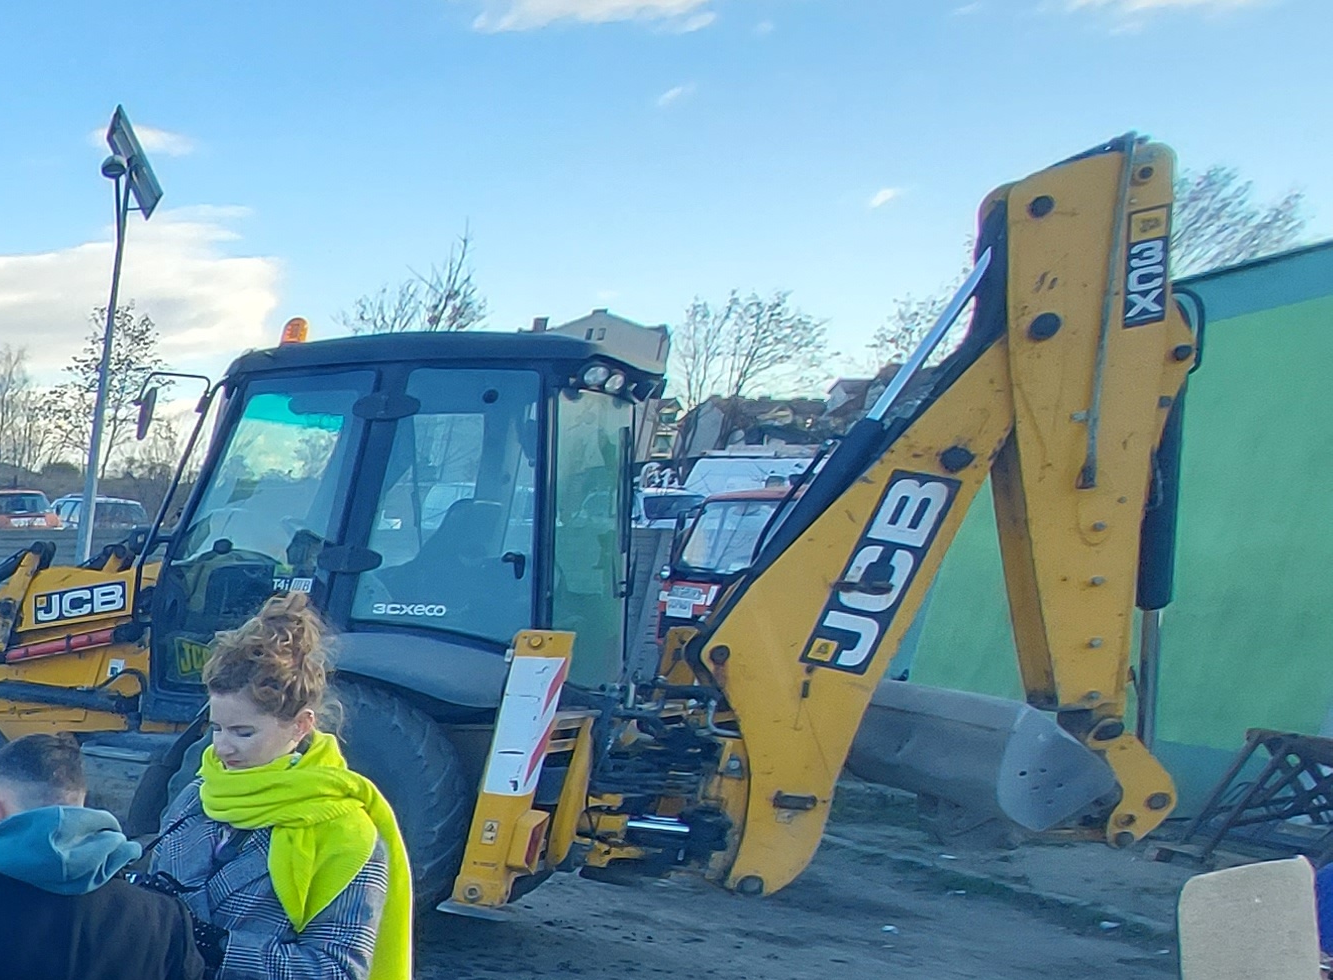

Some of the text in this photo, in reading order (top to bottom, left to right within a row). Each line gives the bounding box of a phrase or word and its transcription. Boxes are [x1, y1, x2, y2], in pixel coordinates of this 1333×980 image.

[1125, 240, 1164, 318] 3CX
[36, 584, 124, 621] JCB
[822, 479, 949, 667] JCB
